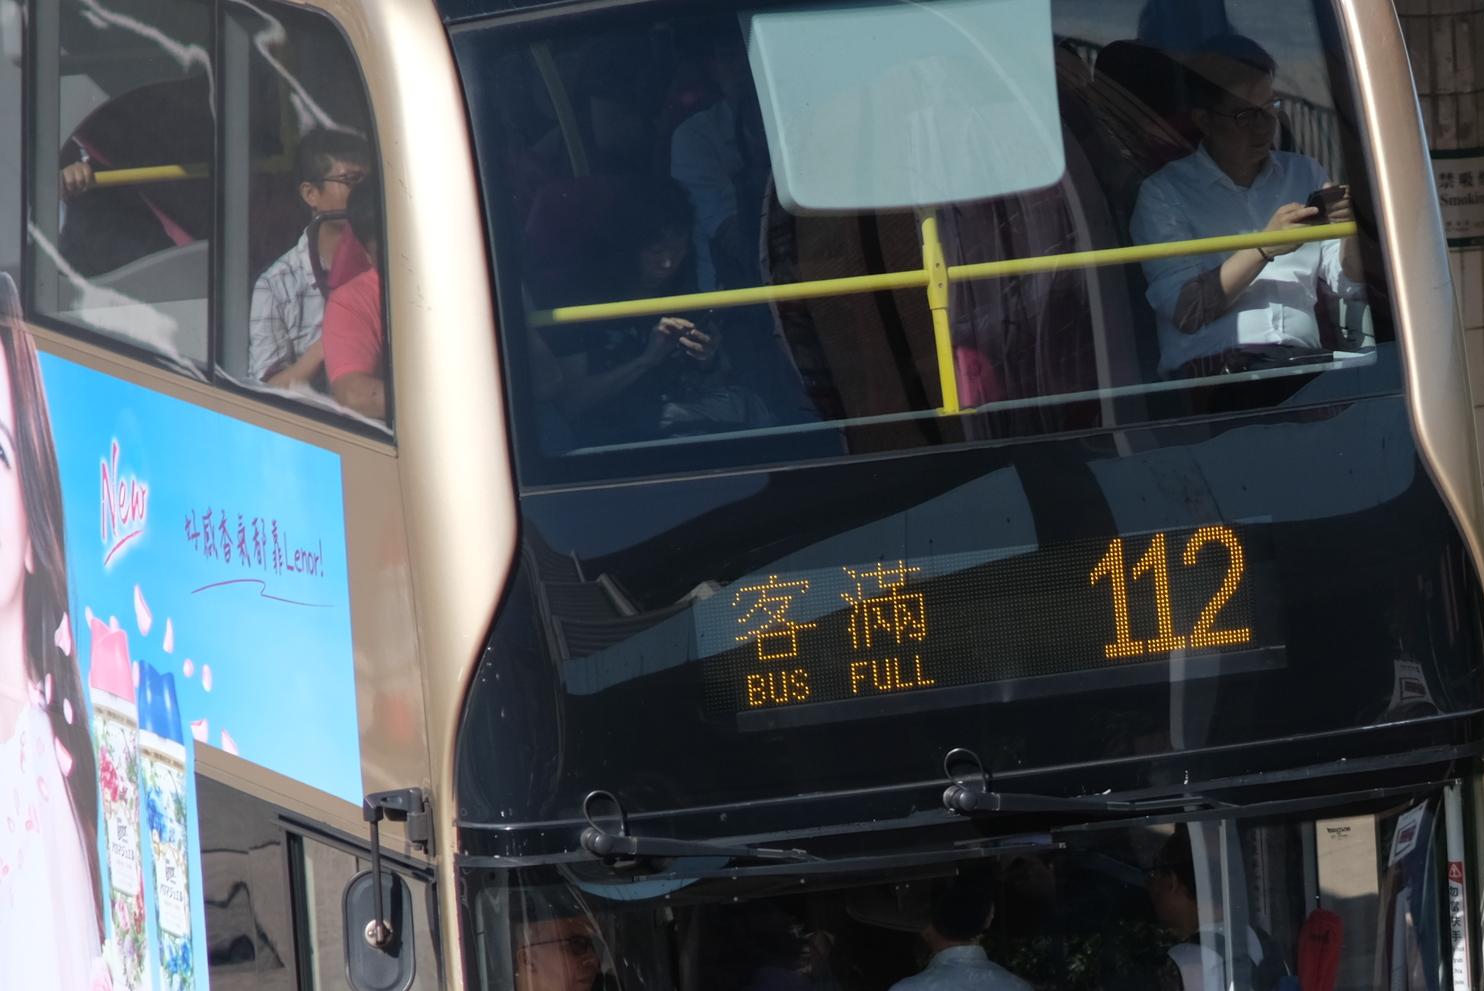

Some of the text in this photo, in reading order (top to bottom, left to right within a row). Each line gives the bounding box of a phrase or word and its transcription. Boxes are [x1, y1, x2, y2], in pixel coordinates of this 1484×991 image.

[102, 442, 147, 541] New
[1090, 526, 1250, 658] 112
[748, 654, 936, 706] BUS FULL
